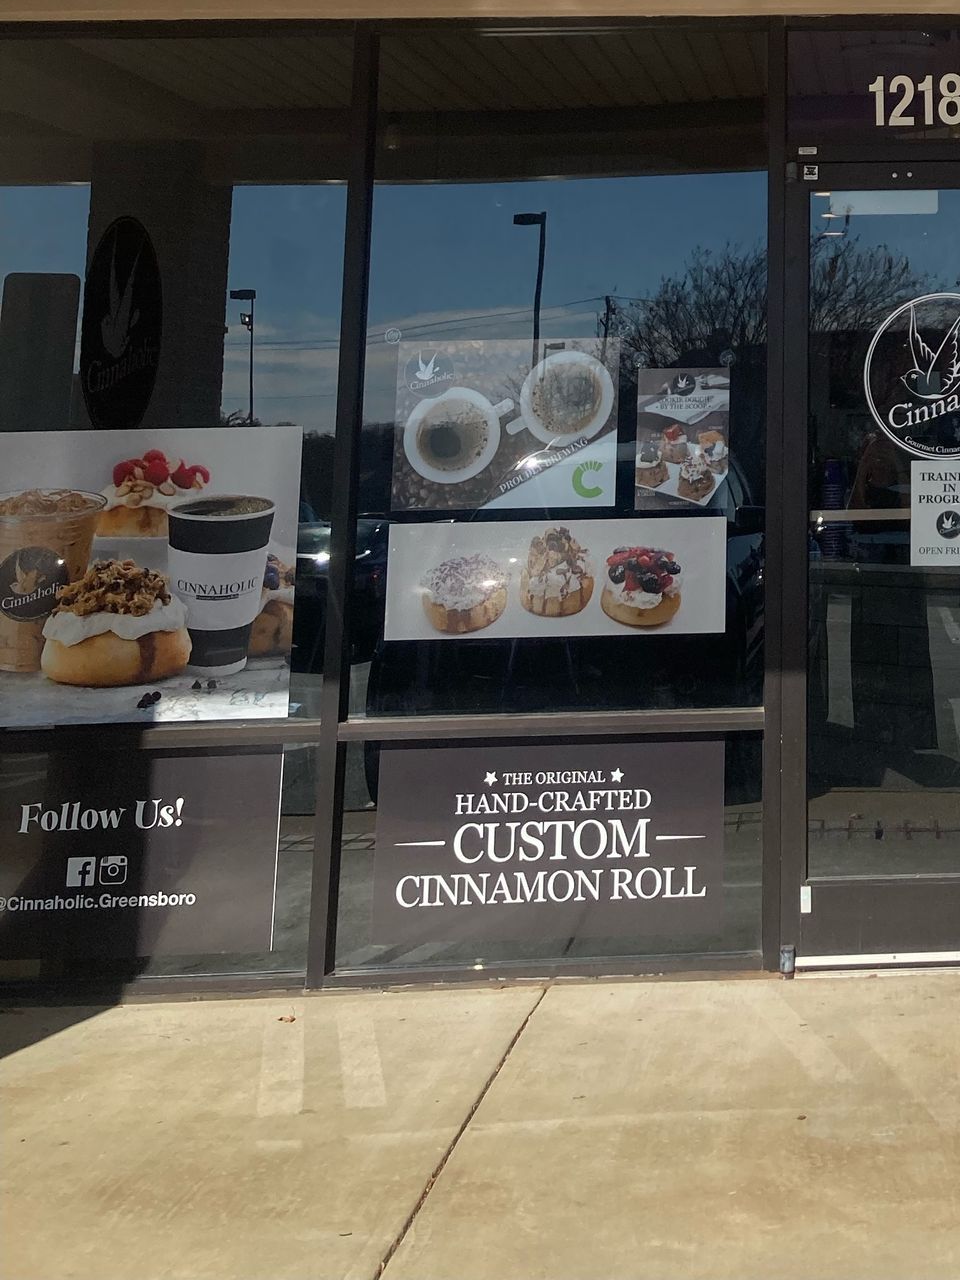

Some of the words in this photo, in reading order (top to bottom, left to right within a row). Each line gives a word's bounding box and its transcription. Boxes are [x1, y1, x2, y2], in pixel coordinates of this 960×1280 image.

[544, 437, 589, 469] BREWING
[943, 483, 956, 493] IN
[918, 547, 943, 555] OPEN
[1, 581, 60, 609] Cinnaholi
[177, 576, 259, 595] CINNAHOLIC
[502, 772, 533, 786] THE
[536, 770, 606, 785] ORIGINAL
[17, 801, 126, 834] Follow
[135, 797, 185, 830] Us!
[454, 789, 652, 816] HAND-CRAFTED
[453, 818, 651, 864] CUSTOM
[395, 869, 604, 908] CINNAMON
[609, 866, 707, 900] ROLL
